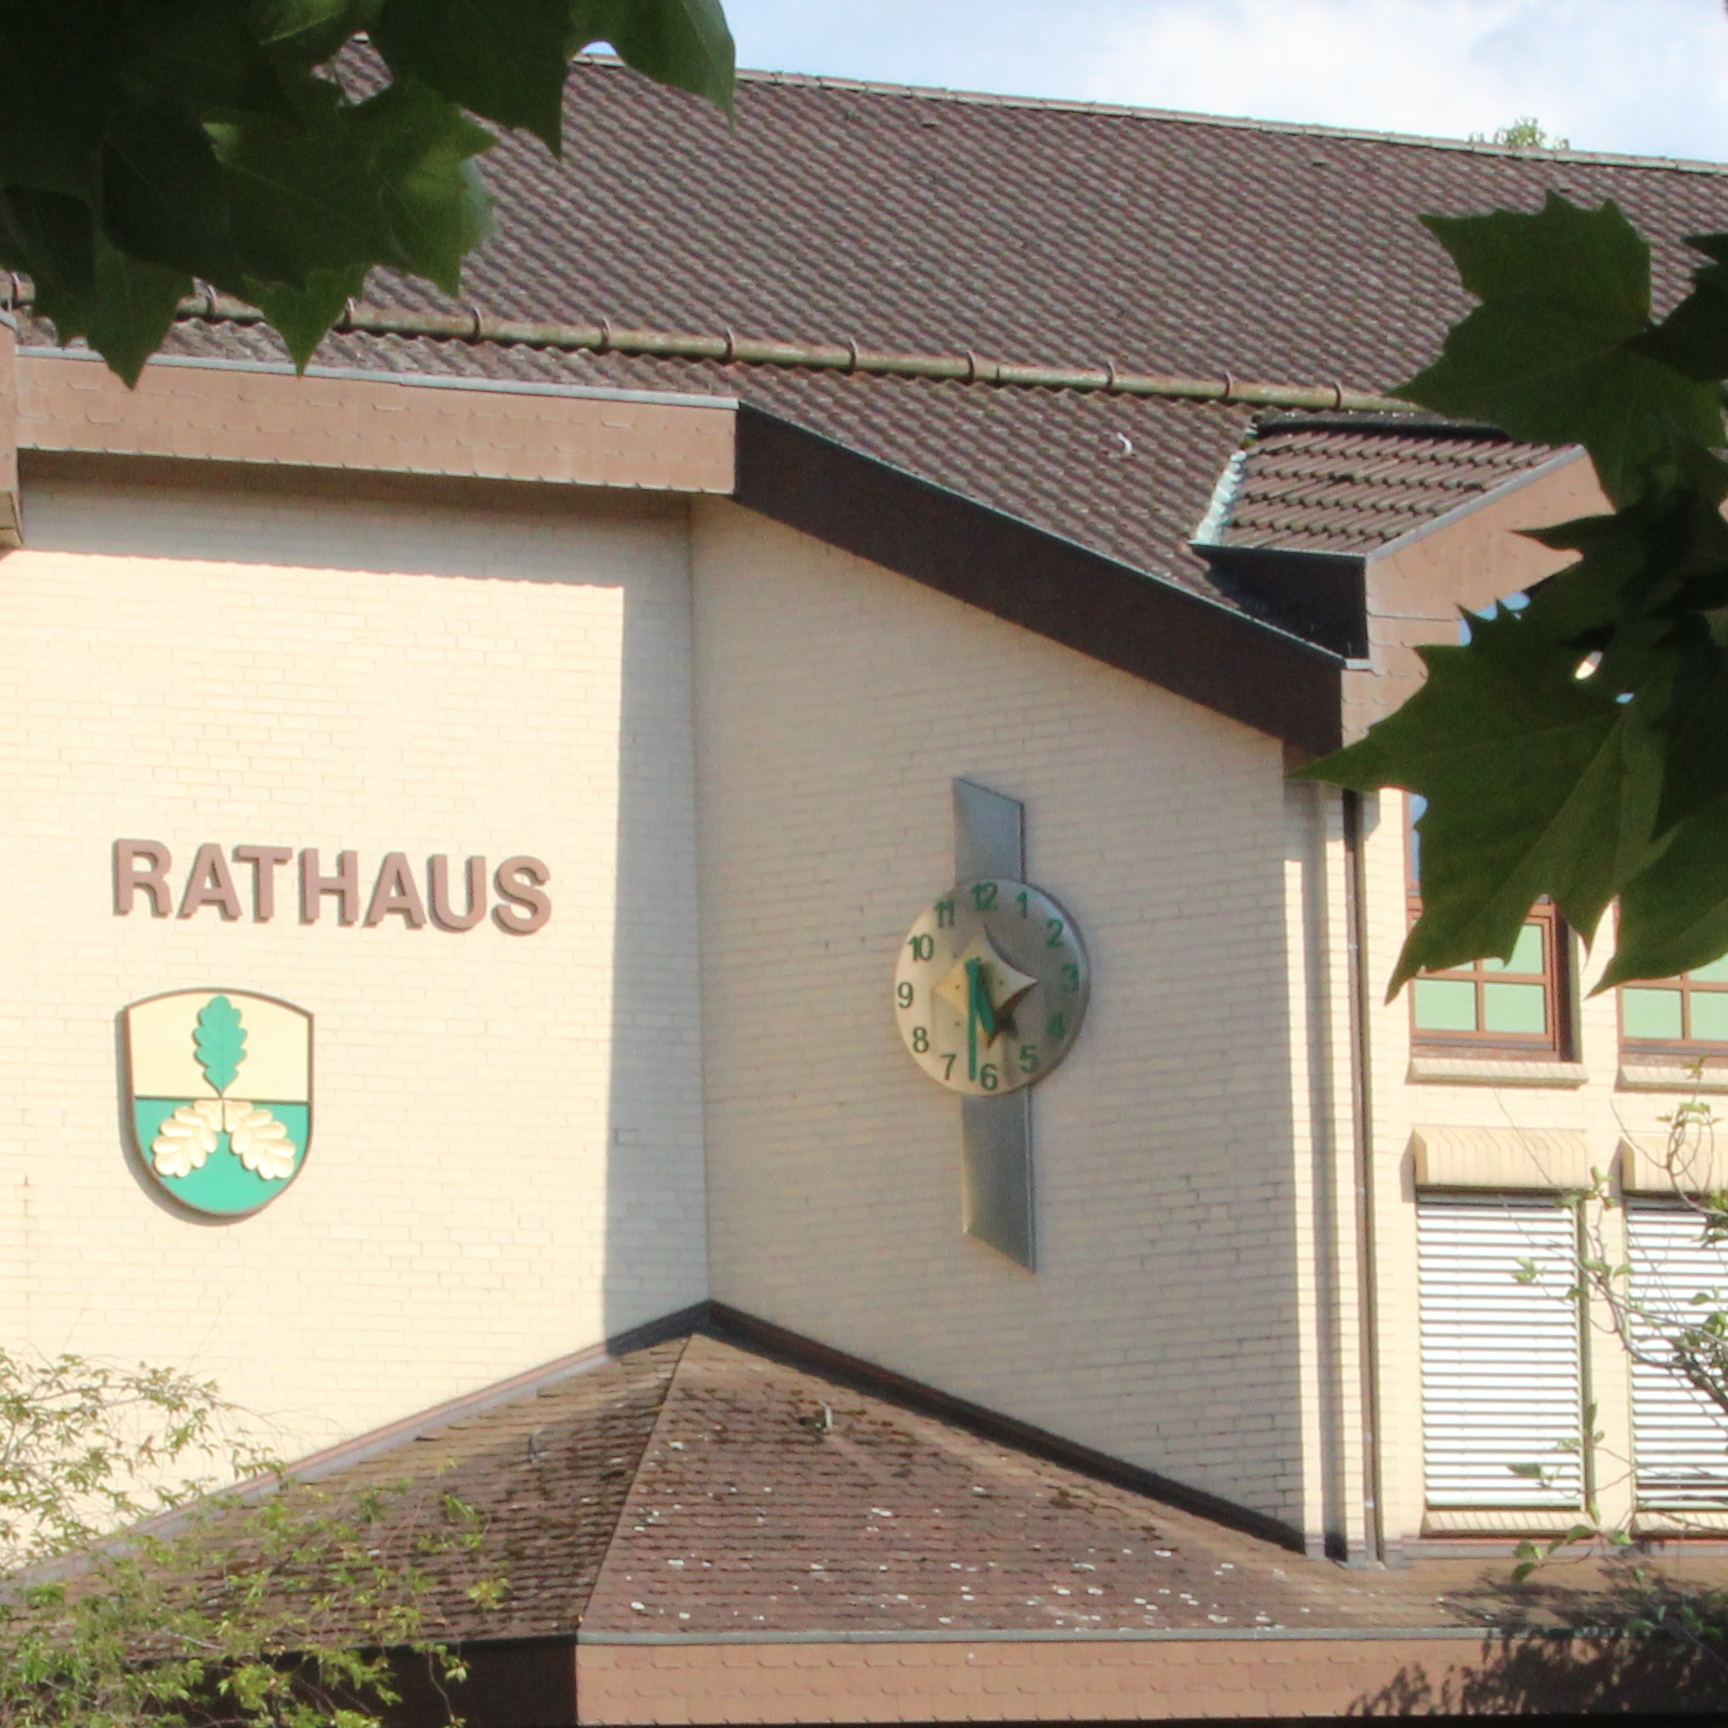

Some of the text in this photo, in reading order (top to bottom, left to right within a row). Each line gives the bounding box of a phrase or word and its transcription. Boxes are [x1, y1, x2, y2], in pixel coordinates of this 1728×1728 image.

[111, 837, 553, 937] RATHAUS
[970, 881, 998, 912] 12
[933, 900, 955, 928] 11
[1017, 891, 1028, 919] 1
[1046, 918, 1064, 948] 2
[908, 934, 935, 962] 10
[1062, 963, 1080, 992] 3
[897, 982, 914, 1008] 9
[912, 1026, 929, 1053] 8
[1046, 1012, 1065, 1040] 4
[940, 1053, 957, 1081] 7
[1020, 1044, 1038, 1074] 5
[980, 1063, 998, 1091] 6
